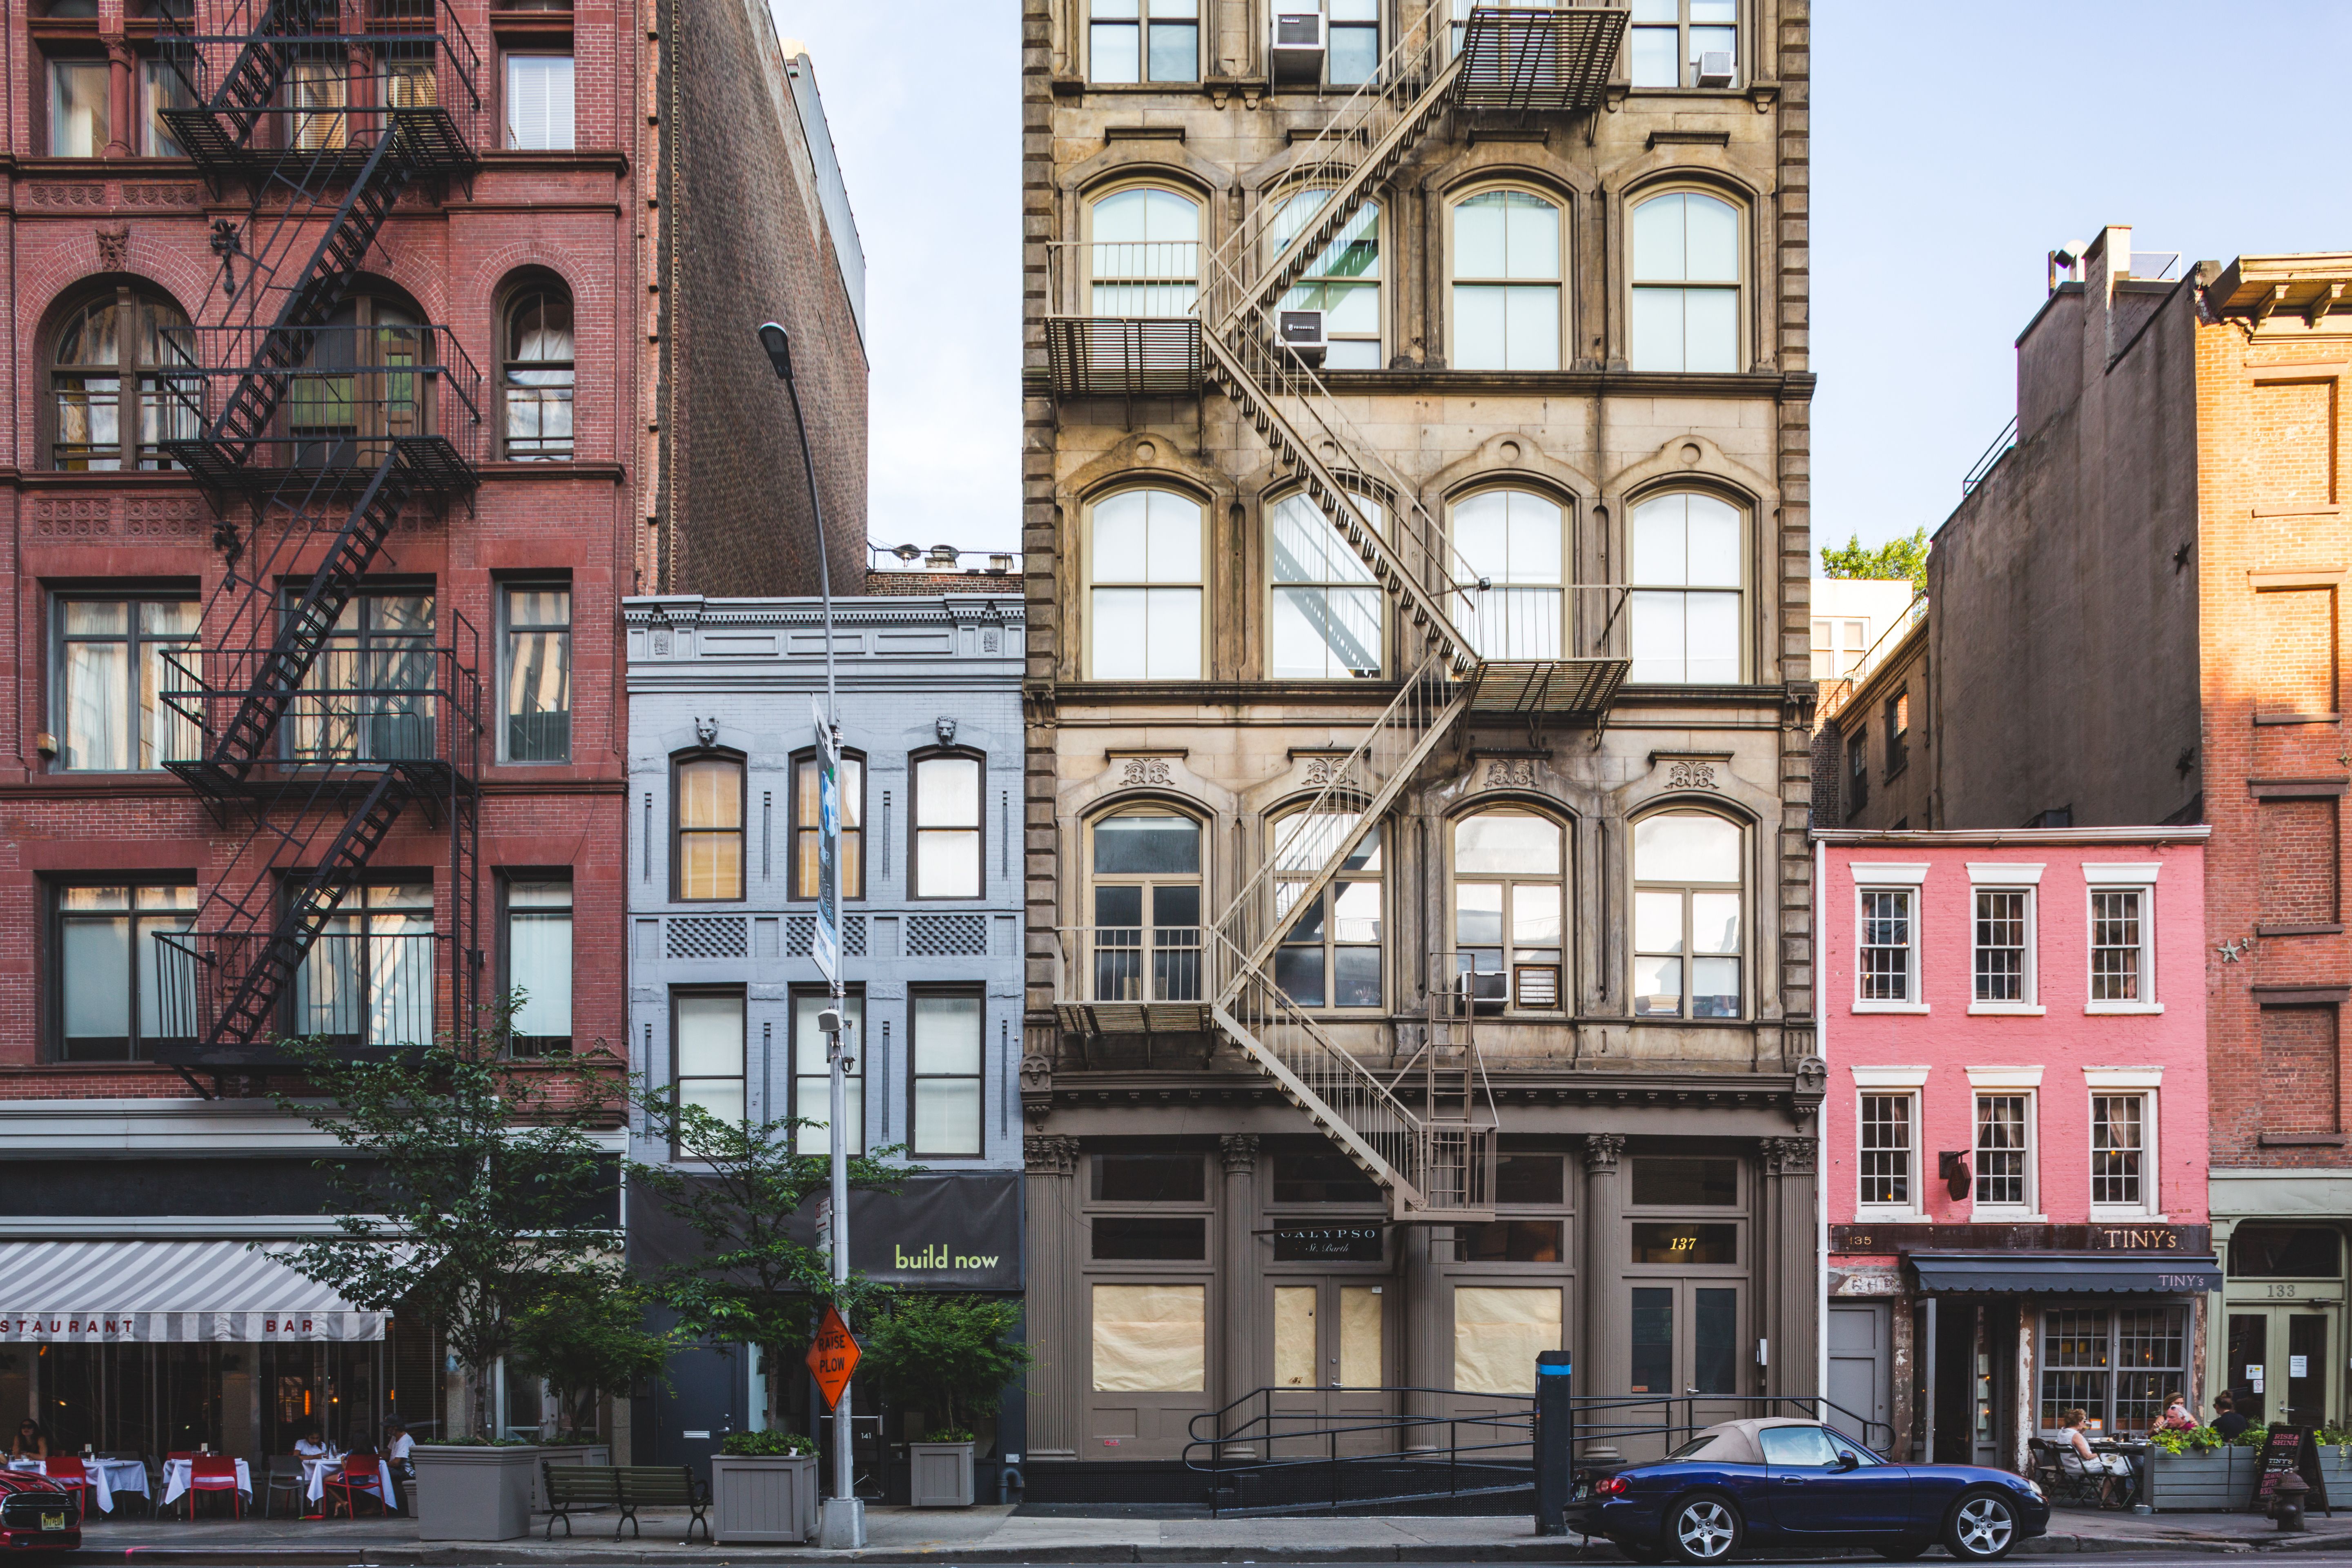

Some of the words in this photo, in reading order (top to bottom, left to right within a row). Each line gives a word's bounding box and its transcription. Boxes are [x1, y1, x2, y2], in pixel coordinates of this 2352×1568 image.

[1281, 1229, 1375, 1238] CALYPSO
[1670, 1238, 1696, 1250] 137
[1849, 1236, 1871, 1245] 135
[1305, 1243, 1318, 1252] St.
[1322, 1243, 1349, 1252] Barth
[896, 1245, 947, 1268] build
[956, 1256, 999, 1269] now
[2267, 1284, 2296, 1298] 133
[0, 1320, 132, 1332] STAURANT
[266, 1320, 313, 1332] BAR
[818, 1334, 845, 1352] RAISE
[820, 1356, 845, 1374] PLOW
